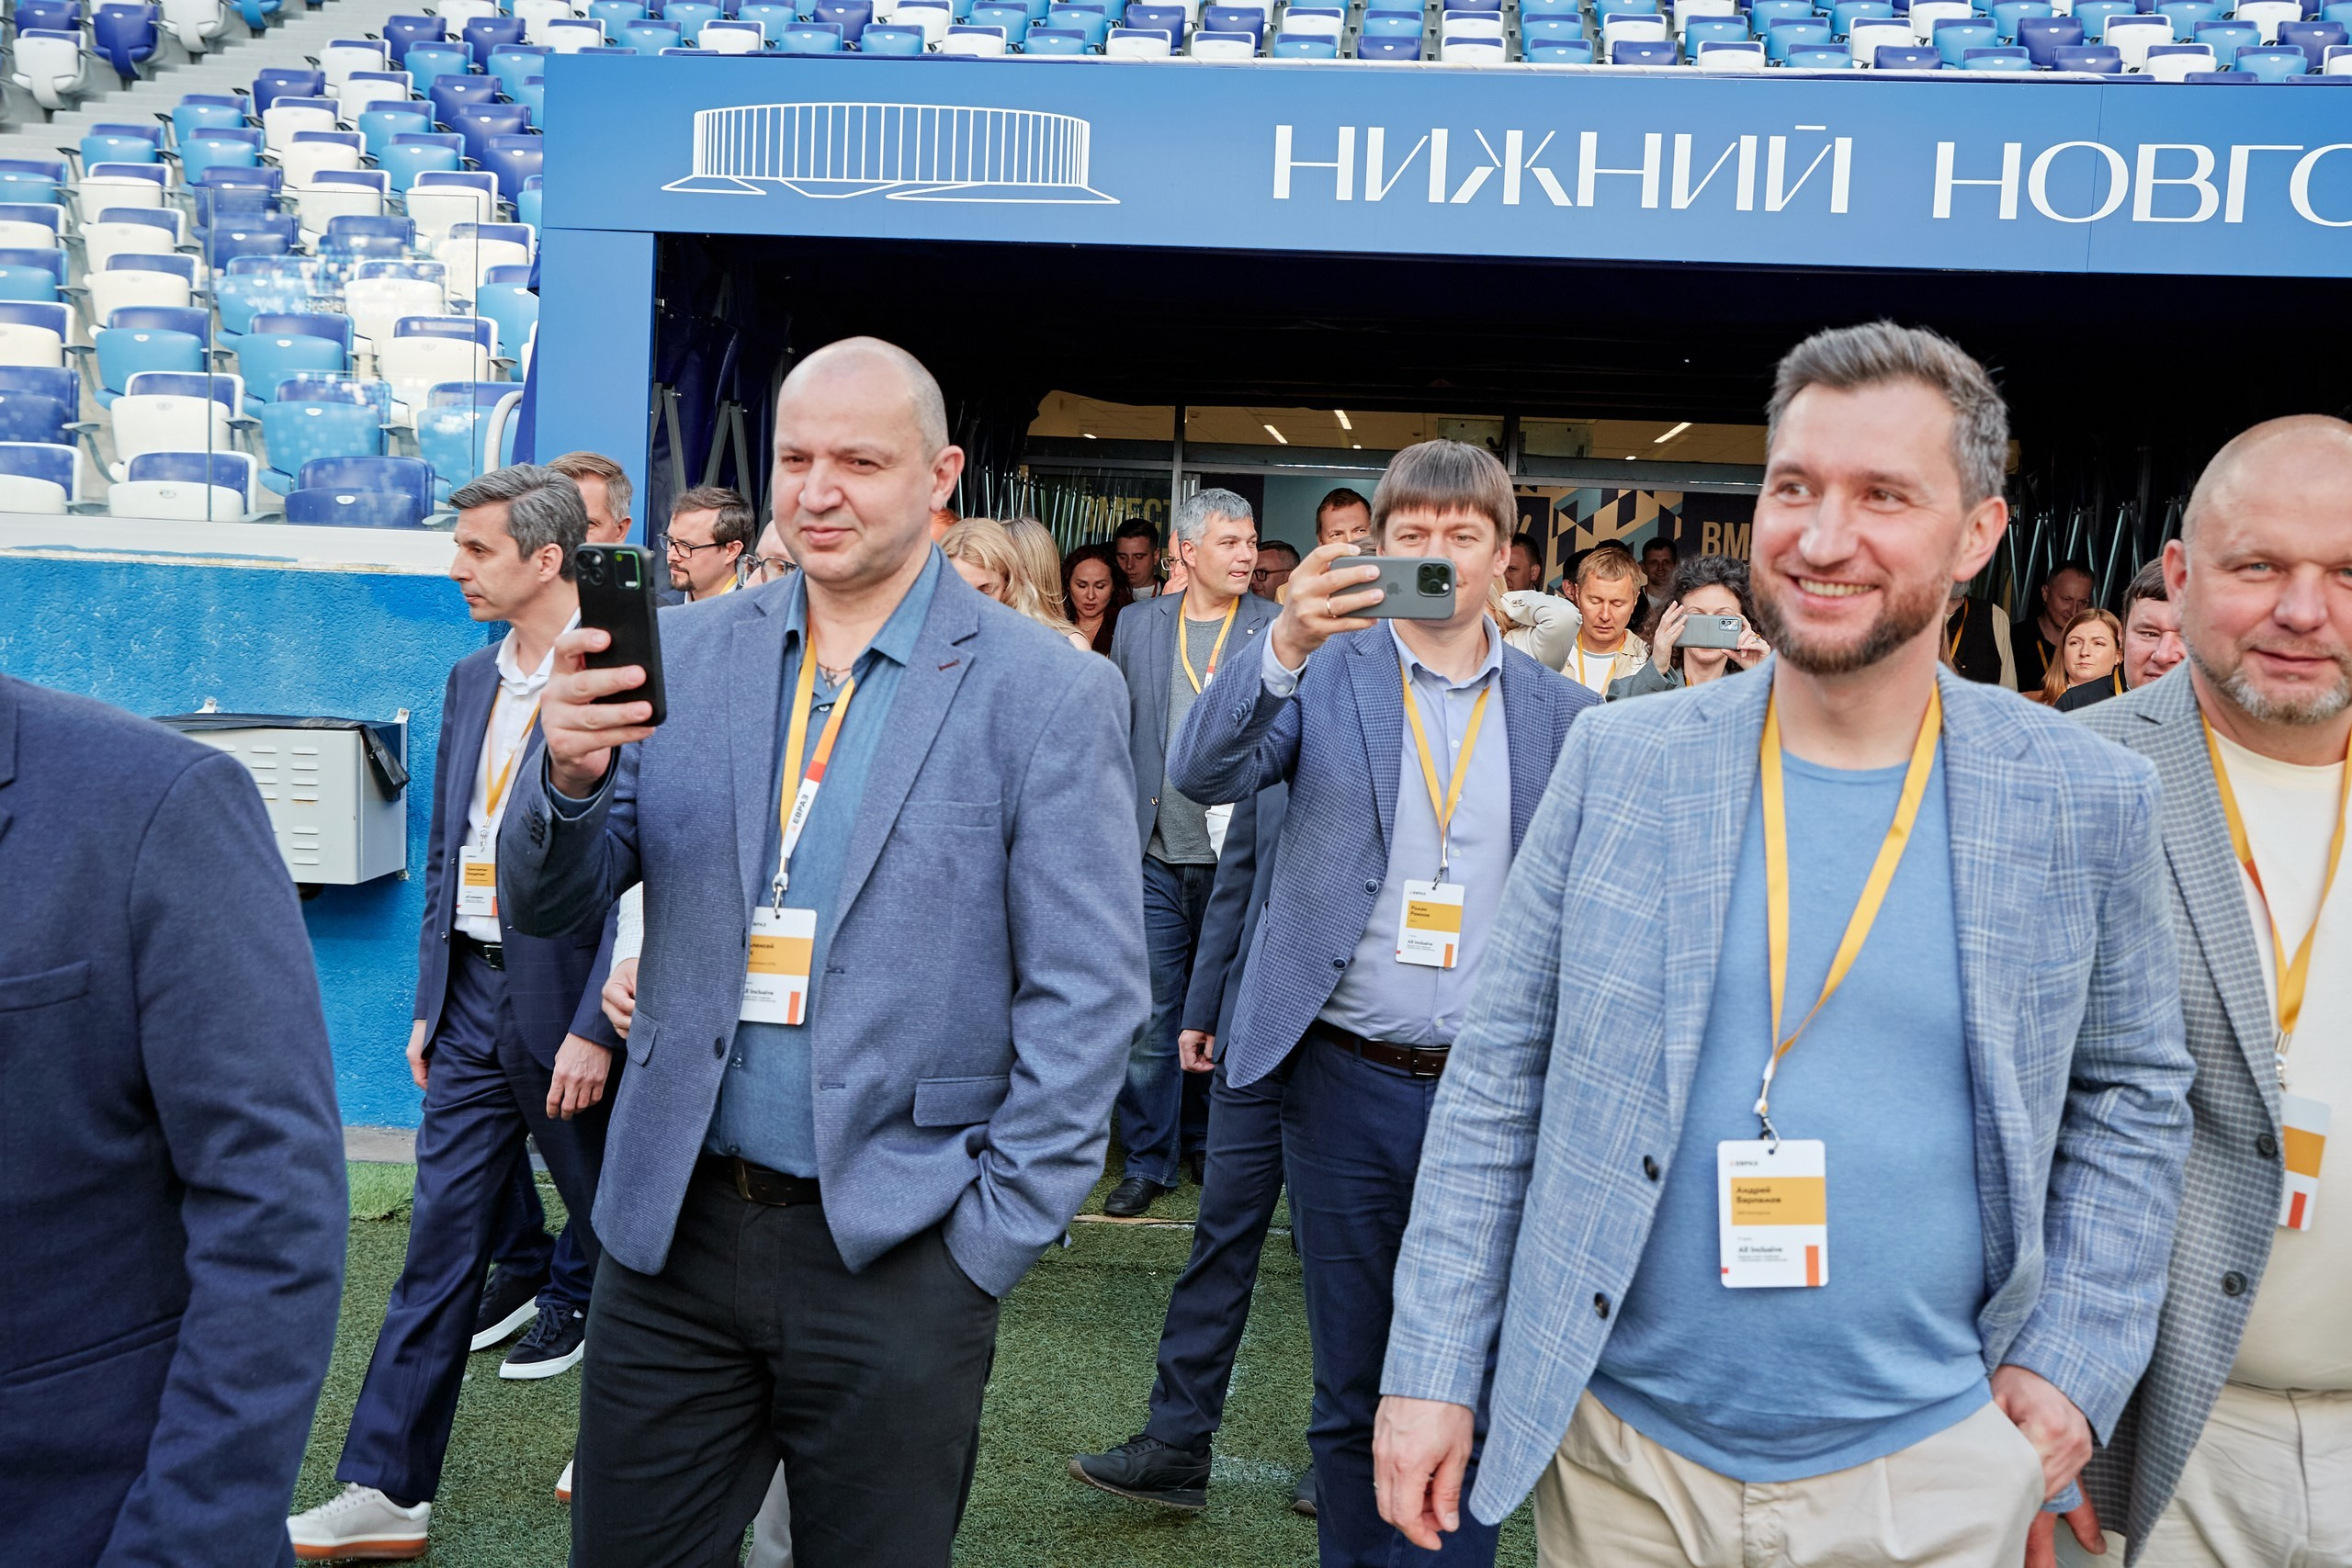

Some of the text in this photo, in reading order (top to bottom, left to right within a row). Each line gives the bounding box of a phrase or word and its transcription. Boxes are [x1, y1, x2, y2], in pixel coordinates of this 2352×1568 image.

[1273, 124, 1853, 214] НИЖНИЙ
[792, 794, 809, 825] ЕВРАЗ
[1736, 1185, 1771, 1195] Андрей
